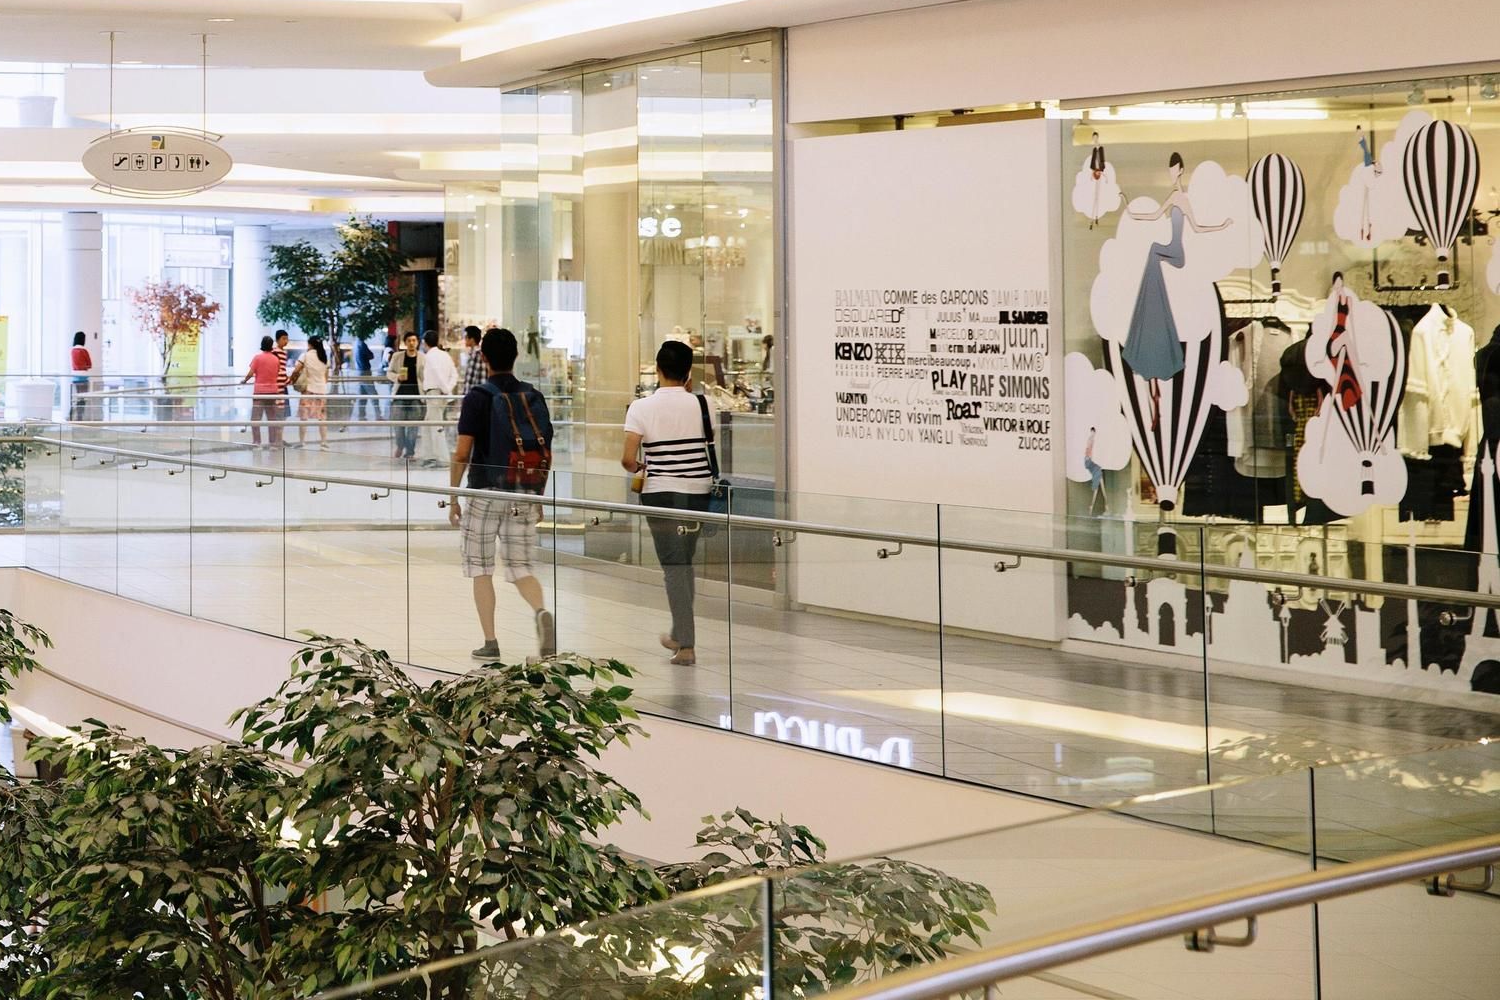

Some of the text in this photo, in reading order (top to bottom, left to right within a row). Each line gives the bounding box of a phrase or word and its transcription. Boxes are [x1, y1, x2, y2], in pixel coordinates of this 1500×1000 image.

[154, 156, 163, 169] P
[638, 217, 681, 238] se
[835, 289, 882, 307] BALMAIN
[883, 289, 918, 305] COMME
[921, 291, 937, 305] des
[835, 327, 906, 339] JUNYA WATANABE
[835, 342, 873, 361] KENZO
[979, 343, 1000, 354] JAPAN
[877, 367, 929, 380] PIERRE HARDY
[931, 369, 967, 391] PLAY
[970, 374, 995, 397] RAF
[999, 374, 1050, 400] SIMONS
[835, 406, 942, 425] UNDERCOVER visvim
[945, 398, 982, 420] Roar
[983, 401, 1051, 415] TSUMORI CHISATO
[835, 425, 954, 445] WANDA NYLON YANG LI
[982, 417, 1017, 432] VIKTOR
[1026, 419, 1051, 435] ROLF
[1018, 436, 1051, 452] zucca
